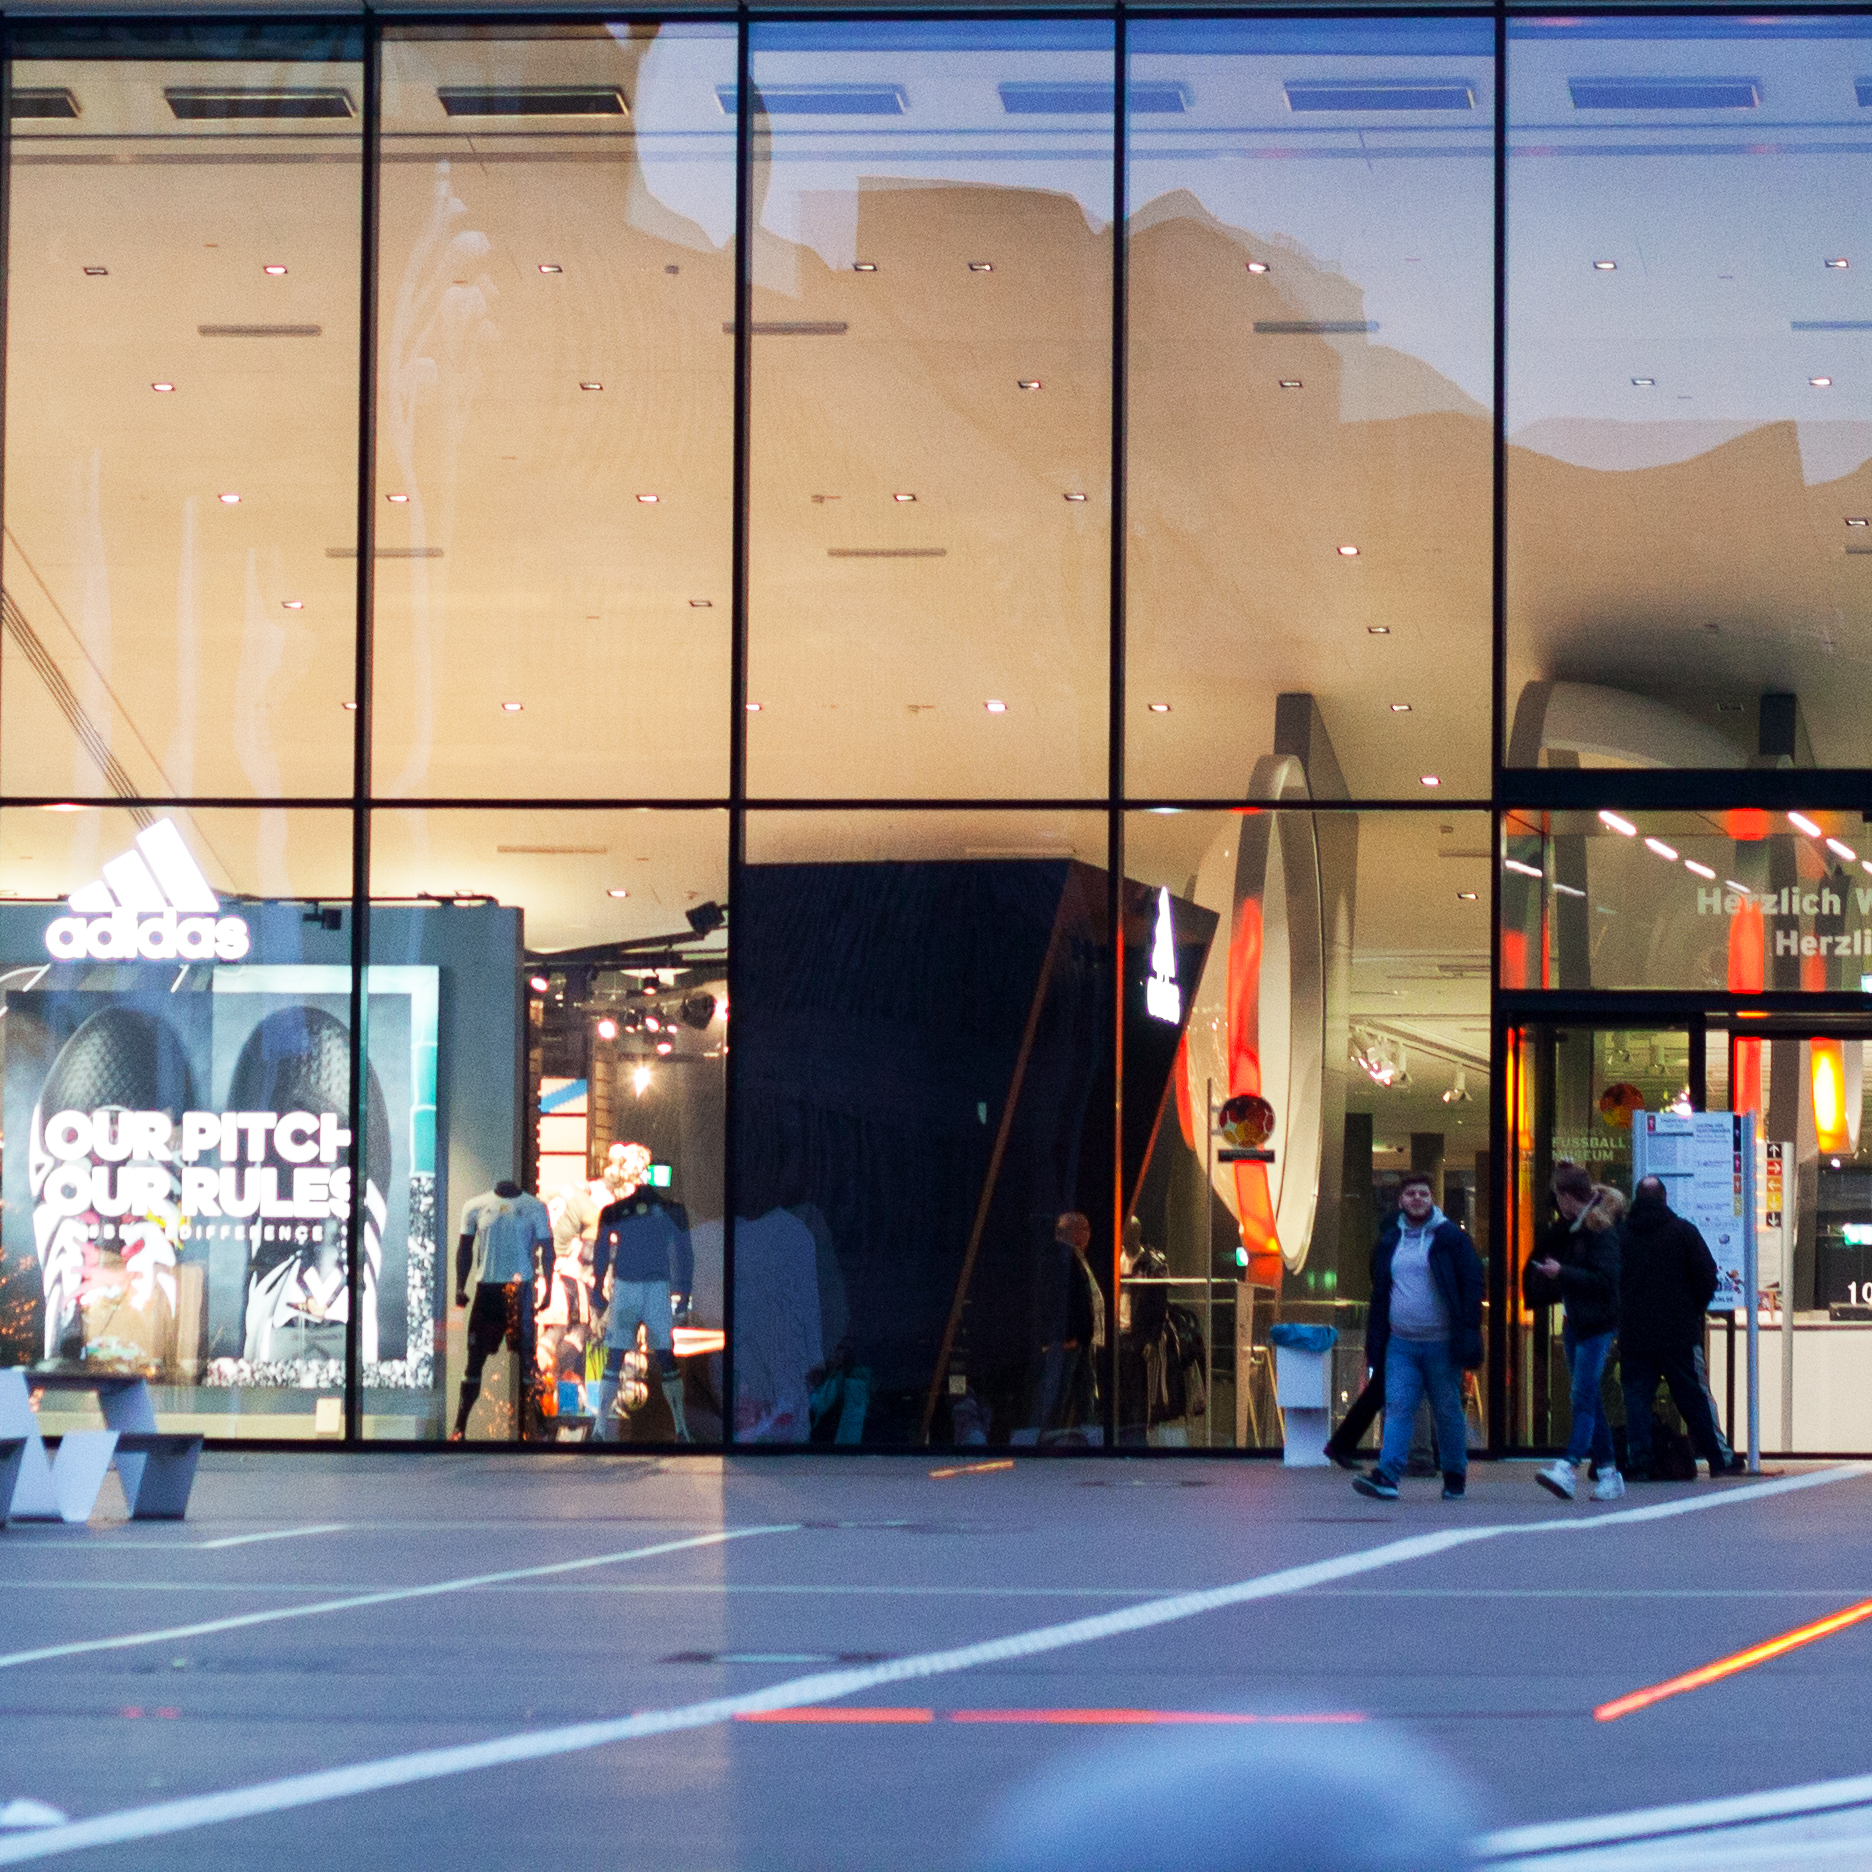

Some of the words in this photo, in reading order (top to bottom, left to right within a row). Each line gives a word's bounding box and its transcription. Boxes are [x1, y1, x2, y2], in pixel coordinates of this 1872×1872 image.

[1696, 886, 1842, 916] Herzlich
[45, 907, 252, 961] adidas
[44, 1109, 173, 1162] OUR
[42, 1164, 172, 1218] OUR
